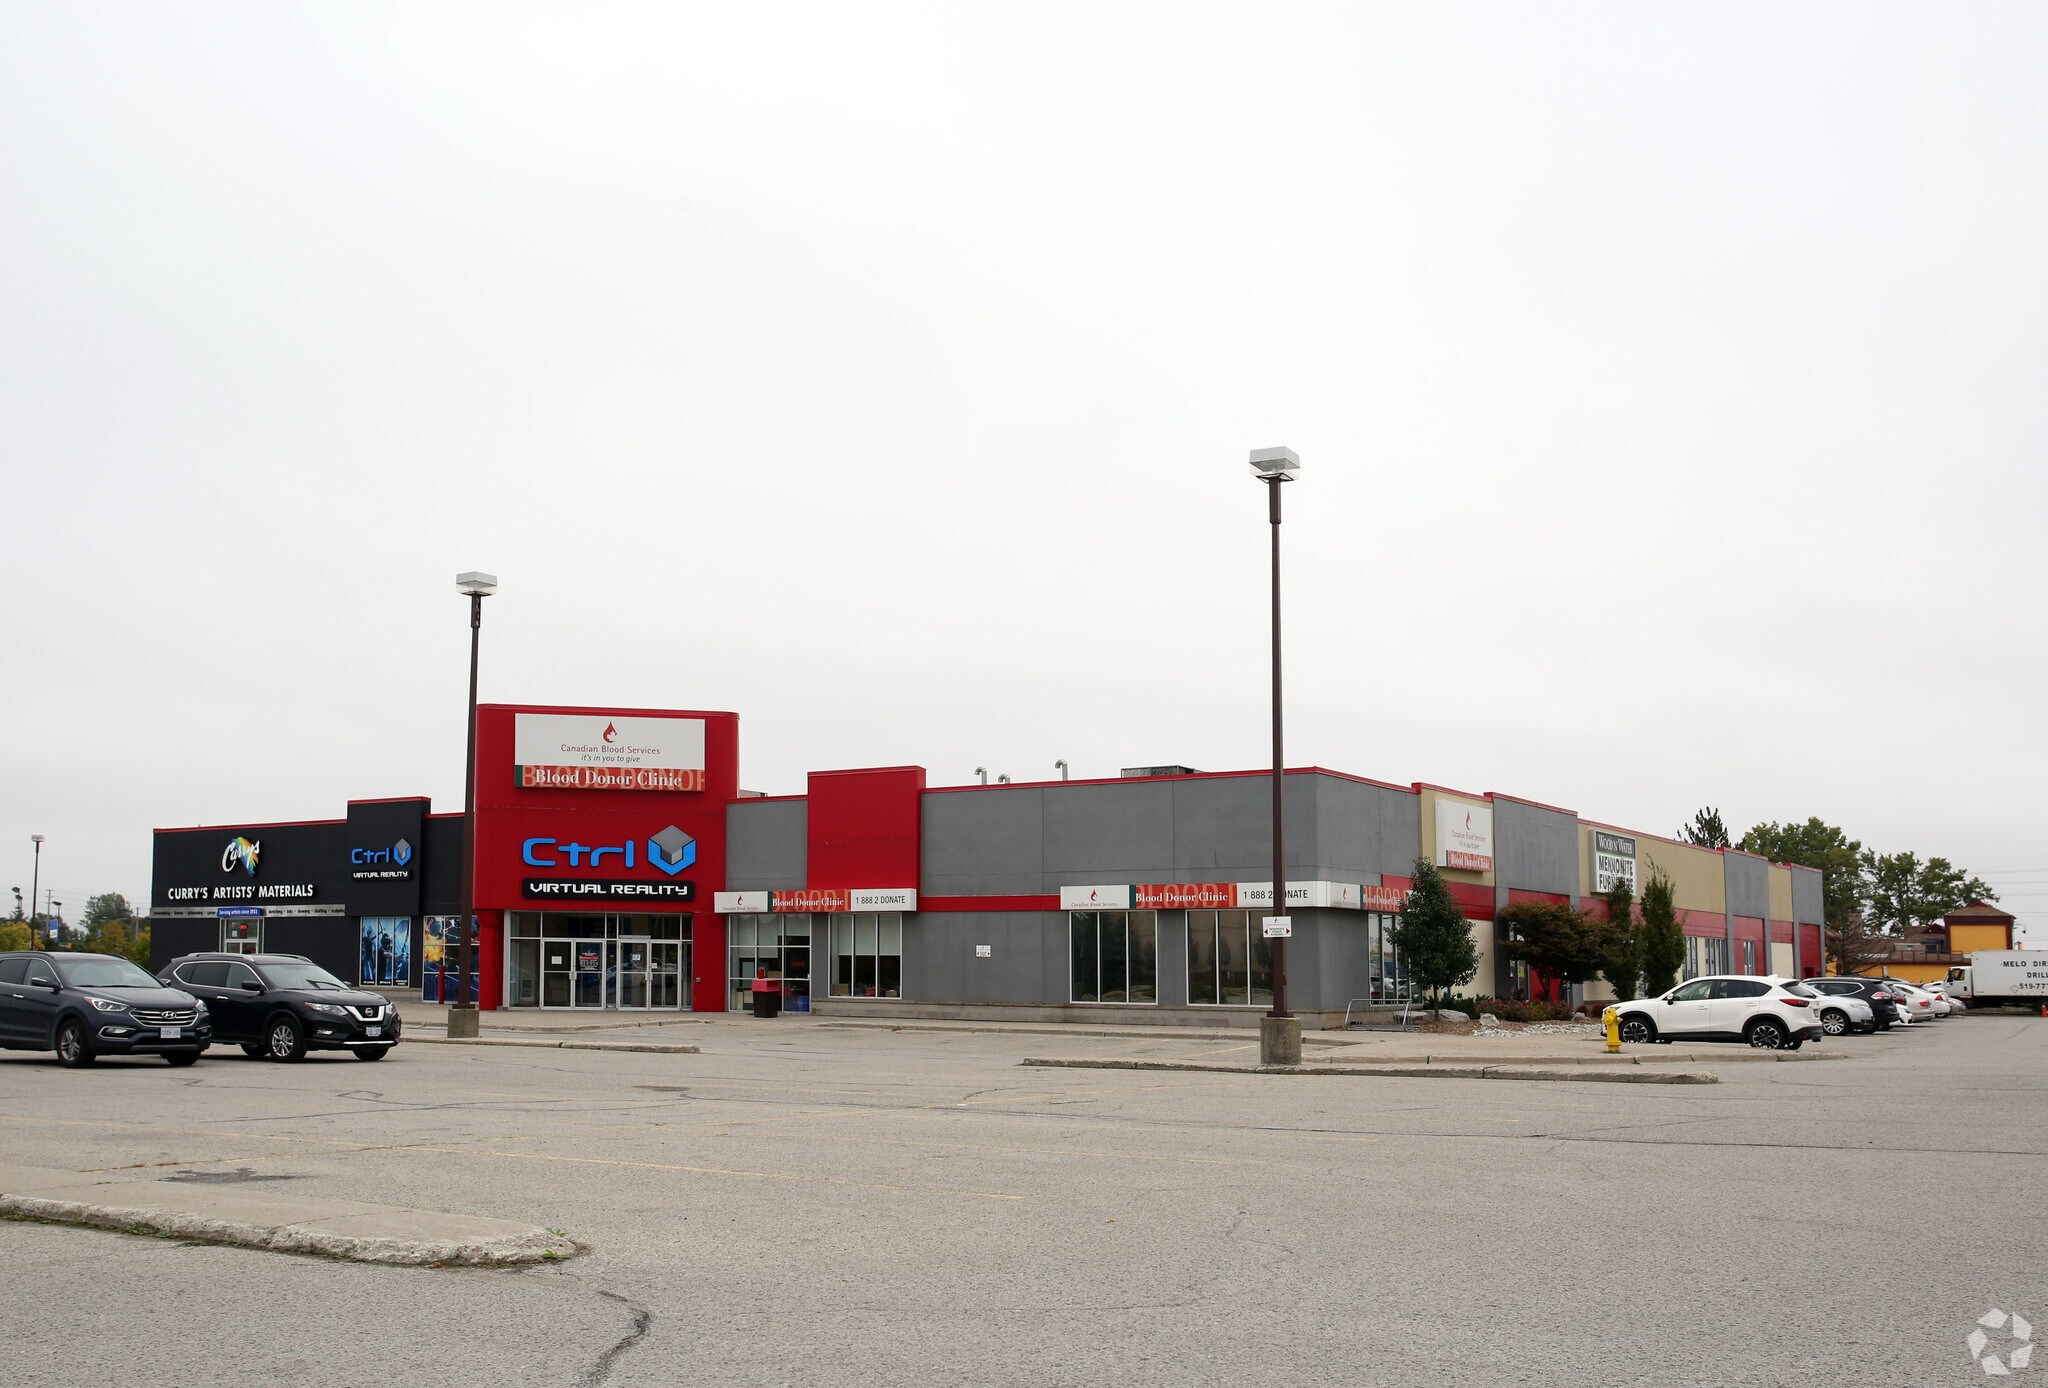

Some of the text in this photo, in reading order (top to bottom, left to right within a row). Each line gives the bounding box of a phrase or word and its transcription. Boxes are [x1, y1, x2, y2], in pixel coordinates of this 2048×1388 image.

[561, 744, 660, 755] Canadian Blood Services
[581, 754, 592, 762] it's
[626, 756, 641, 764] give
[535, 769, 682, 787] Blood Donor Clinic
[222, 840, 260, 873] Currys
[351, 847, 390, 864] Ctrl
[522, 837, 635, 868] Ctrl
[168, 884, 314, 899] CURRY'S ARTISTS' MATERIALS
[530, 882, 688, 895] VIRTUAL REALITY
[855, 895, 906, 905] 1 888 2 DONATE
[1135, 892, 1228, 903] Blood Donor Clinic
[1243, 891, 1248, 899] 1
[1250, 890, 1266, 900] 888
[1268, 890, 1273, 899] 2
[772, 896, 844, 907] Blood Donor Clinic
